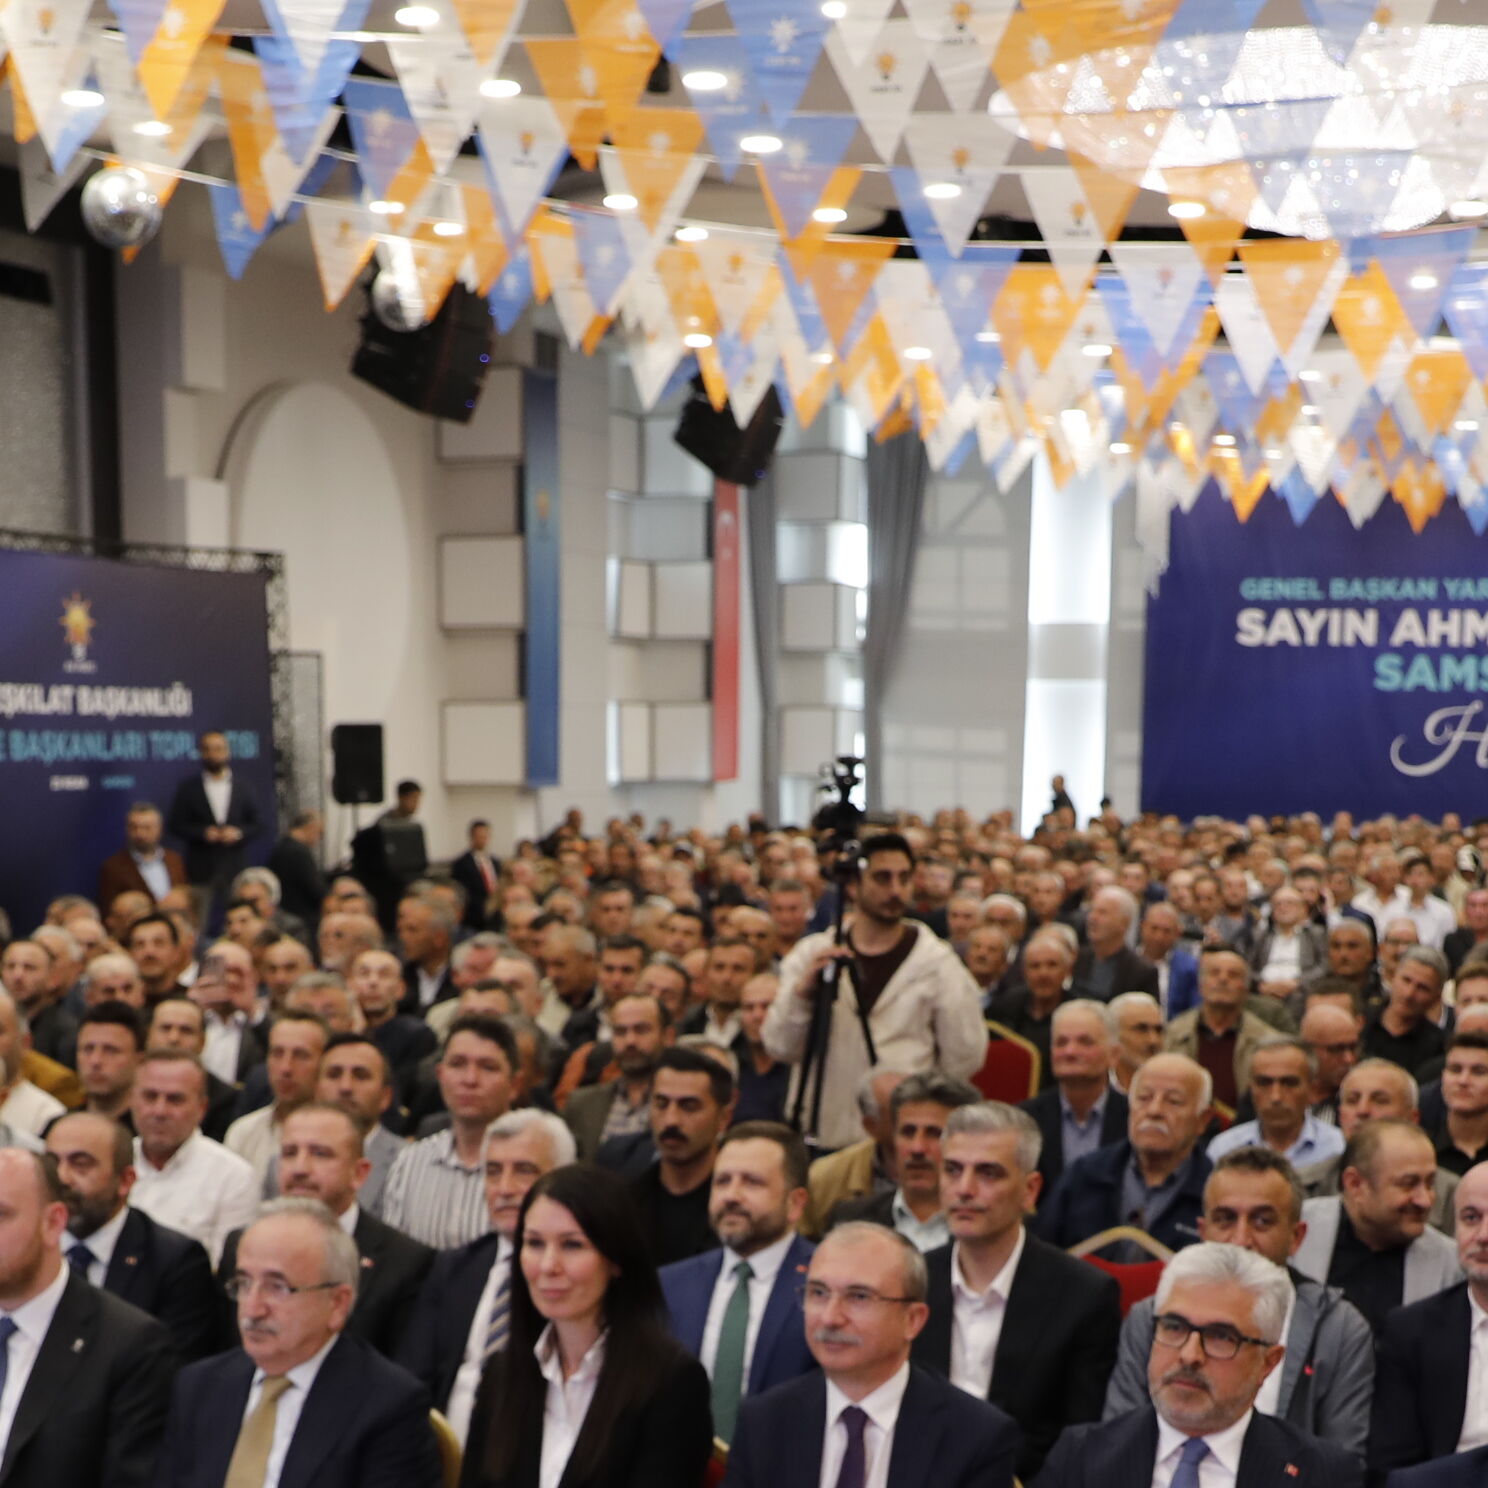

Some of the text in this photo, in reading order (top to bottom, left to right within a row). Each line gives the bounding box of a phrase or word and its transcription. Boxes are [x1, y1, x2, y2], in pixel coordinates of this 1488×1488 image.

[1239, 577, 1324, 601] GENEL
[1329, 577, 1438, 604] BAŞKAN
[1235, 607, 1379, 648] SAYIN
